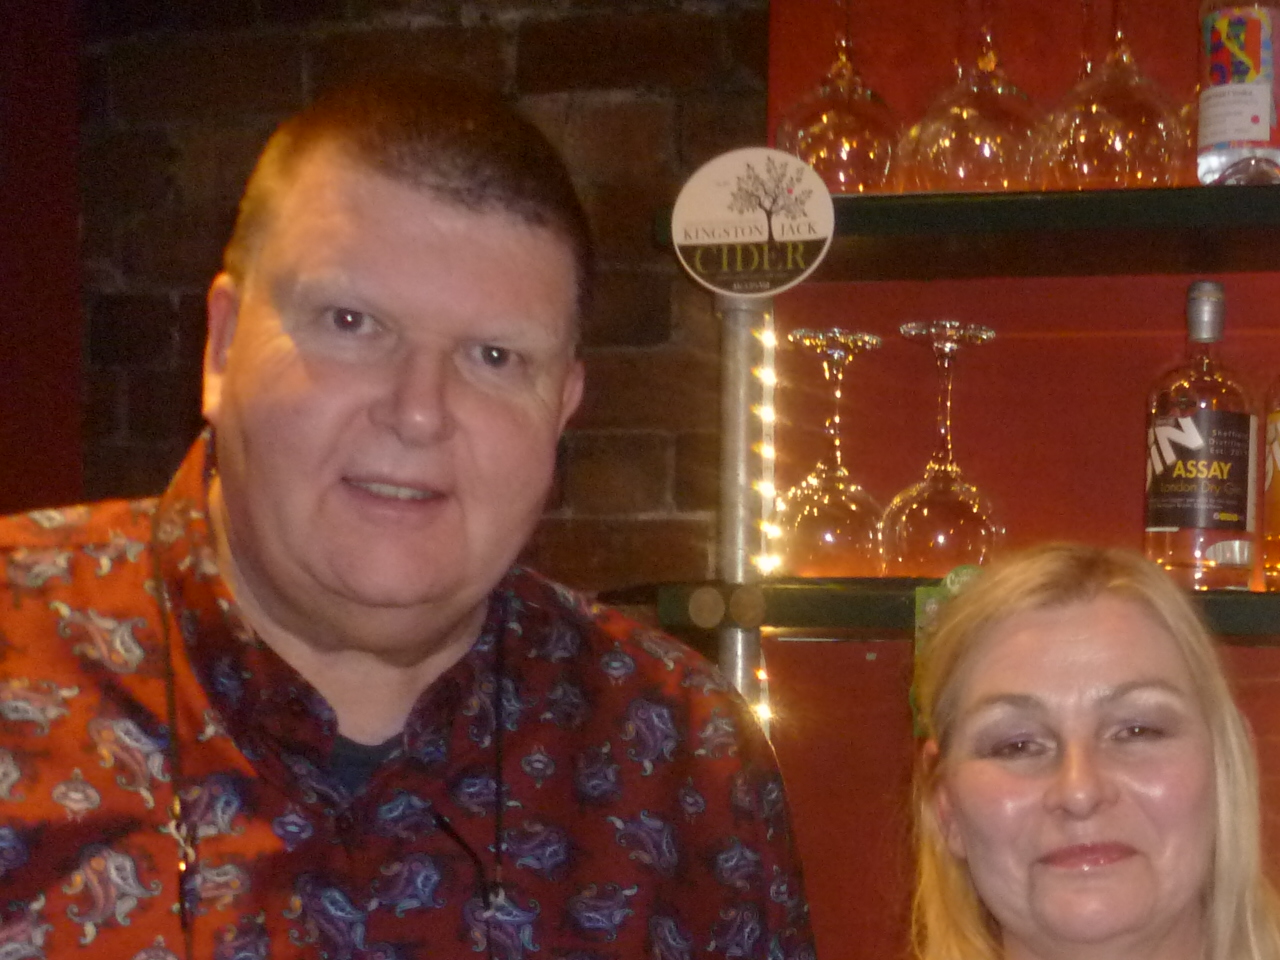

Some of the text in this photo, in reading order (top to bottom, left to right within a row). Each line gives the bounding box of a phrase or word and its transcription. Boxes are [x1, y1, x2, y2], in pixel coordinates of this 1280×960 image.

[684, 222, 818, 242] KINGSTON JACK
[694, 243, 806, 273] CIDER
[1173, 460, 1232, 479] ASSAY
